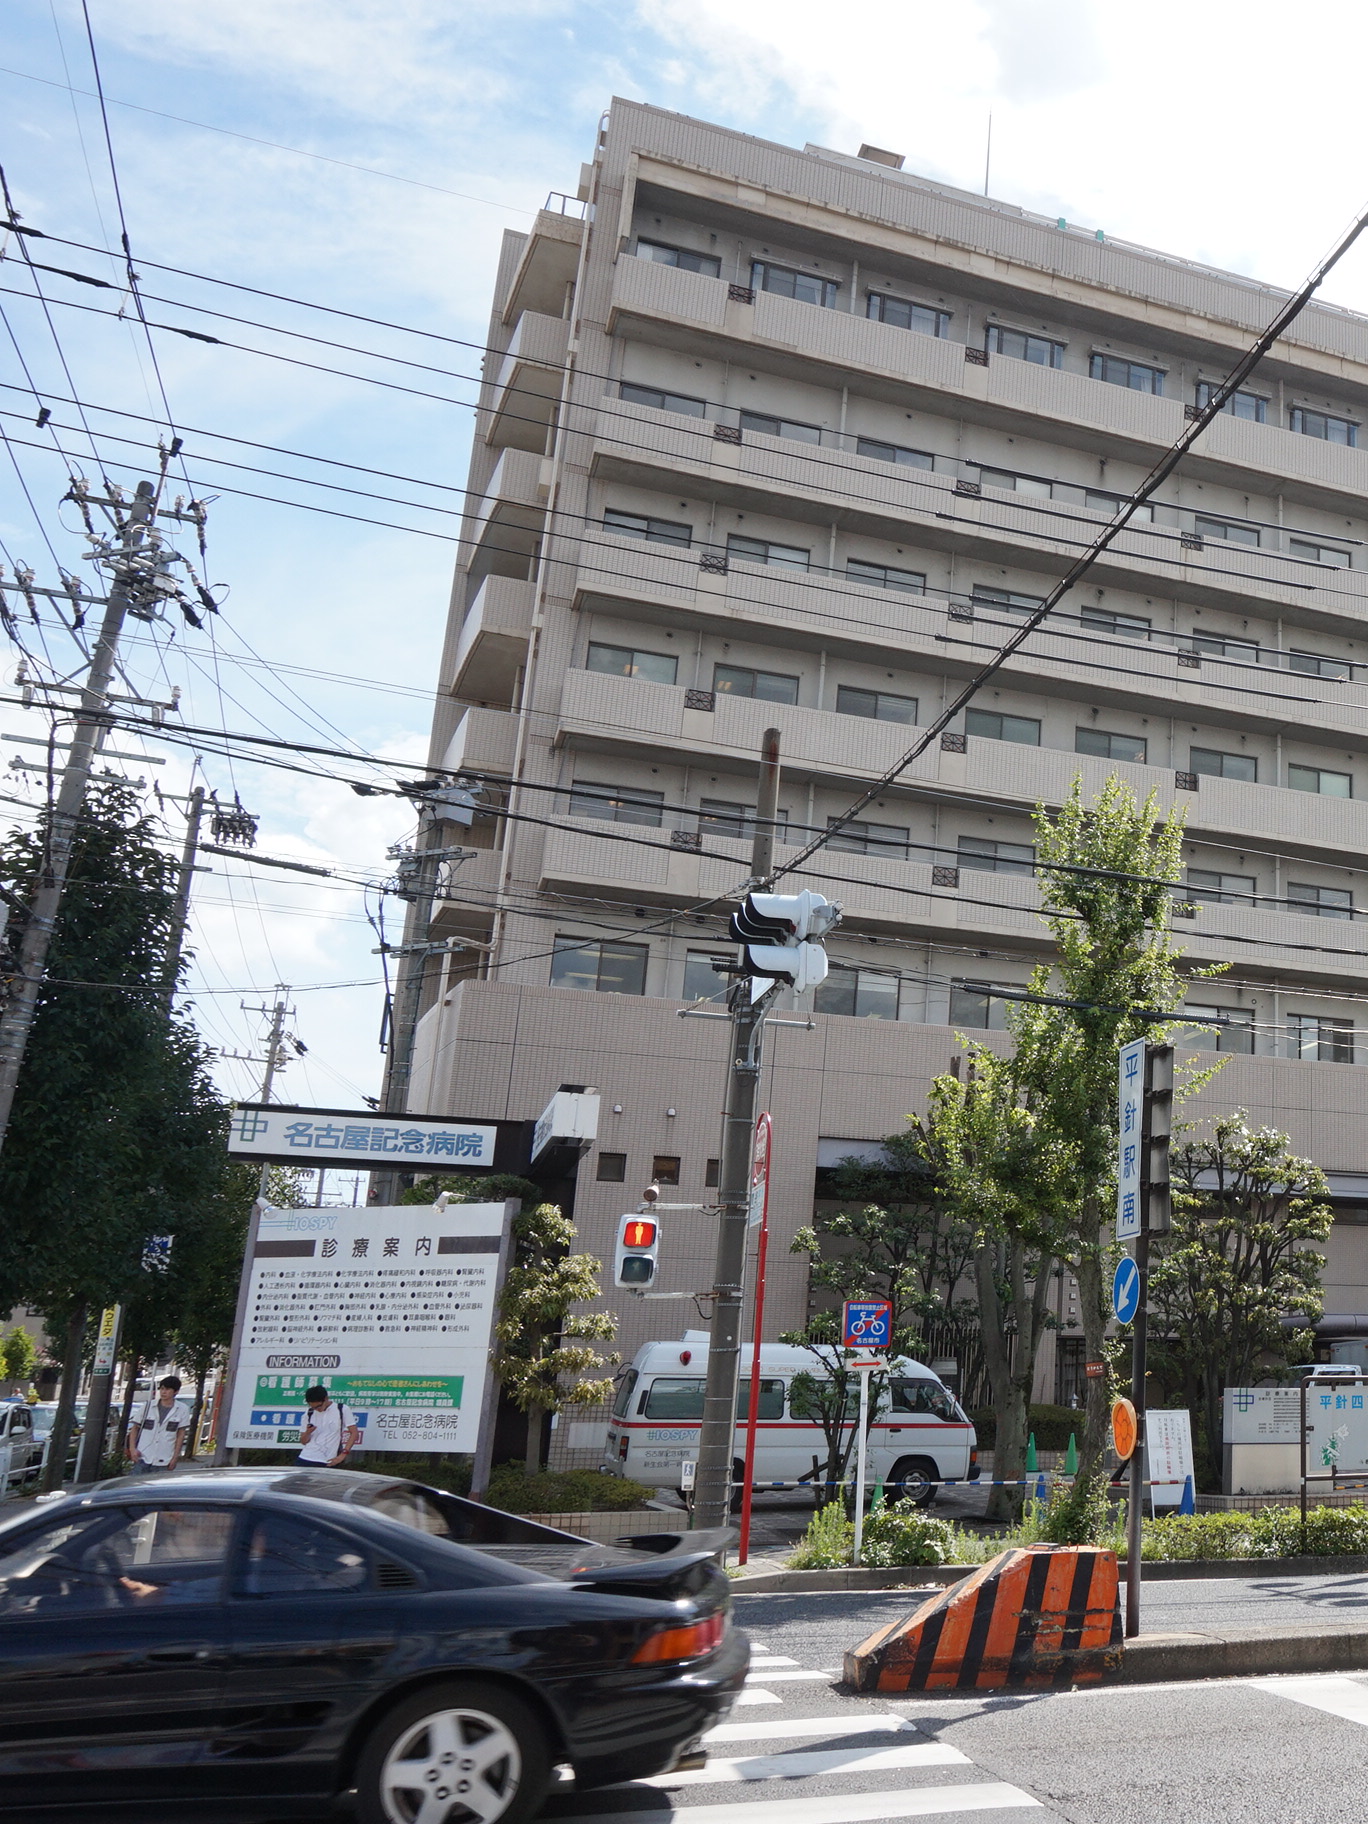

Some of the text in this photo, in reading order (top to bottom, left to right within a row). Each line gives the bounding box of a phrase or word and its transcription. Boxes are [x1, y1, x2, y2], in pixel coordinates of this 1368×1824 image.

[283, 1122, 483, 1157] 名古屋記念病院
[1122, 1053, 1138, 1226] 平針駅南
[323, 1237, 432, 1258] 診療案内
[269, 1356, 337, 1368] INFORMATION
[376, 1414, 458, 1429] 名古屋記念病院
[232, 1430, 274, 1440] 保険医療機関
[384, 1431, 456, 1440] TEL 052-804-1111
